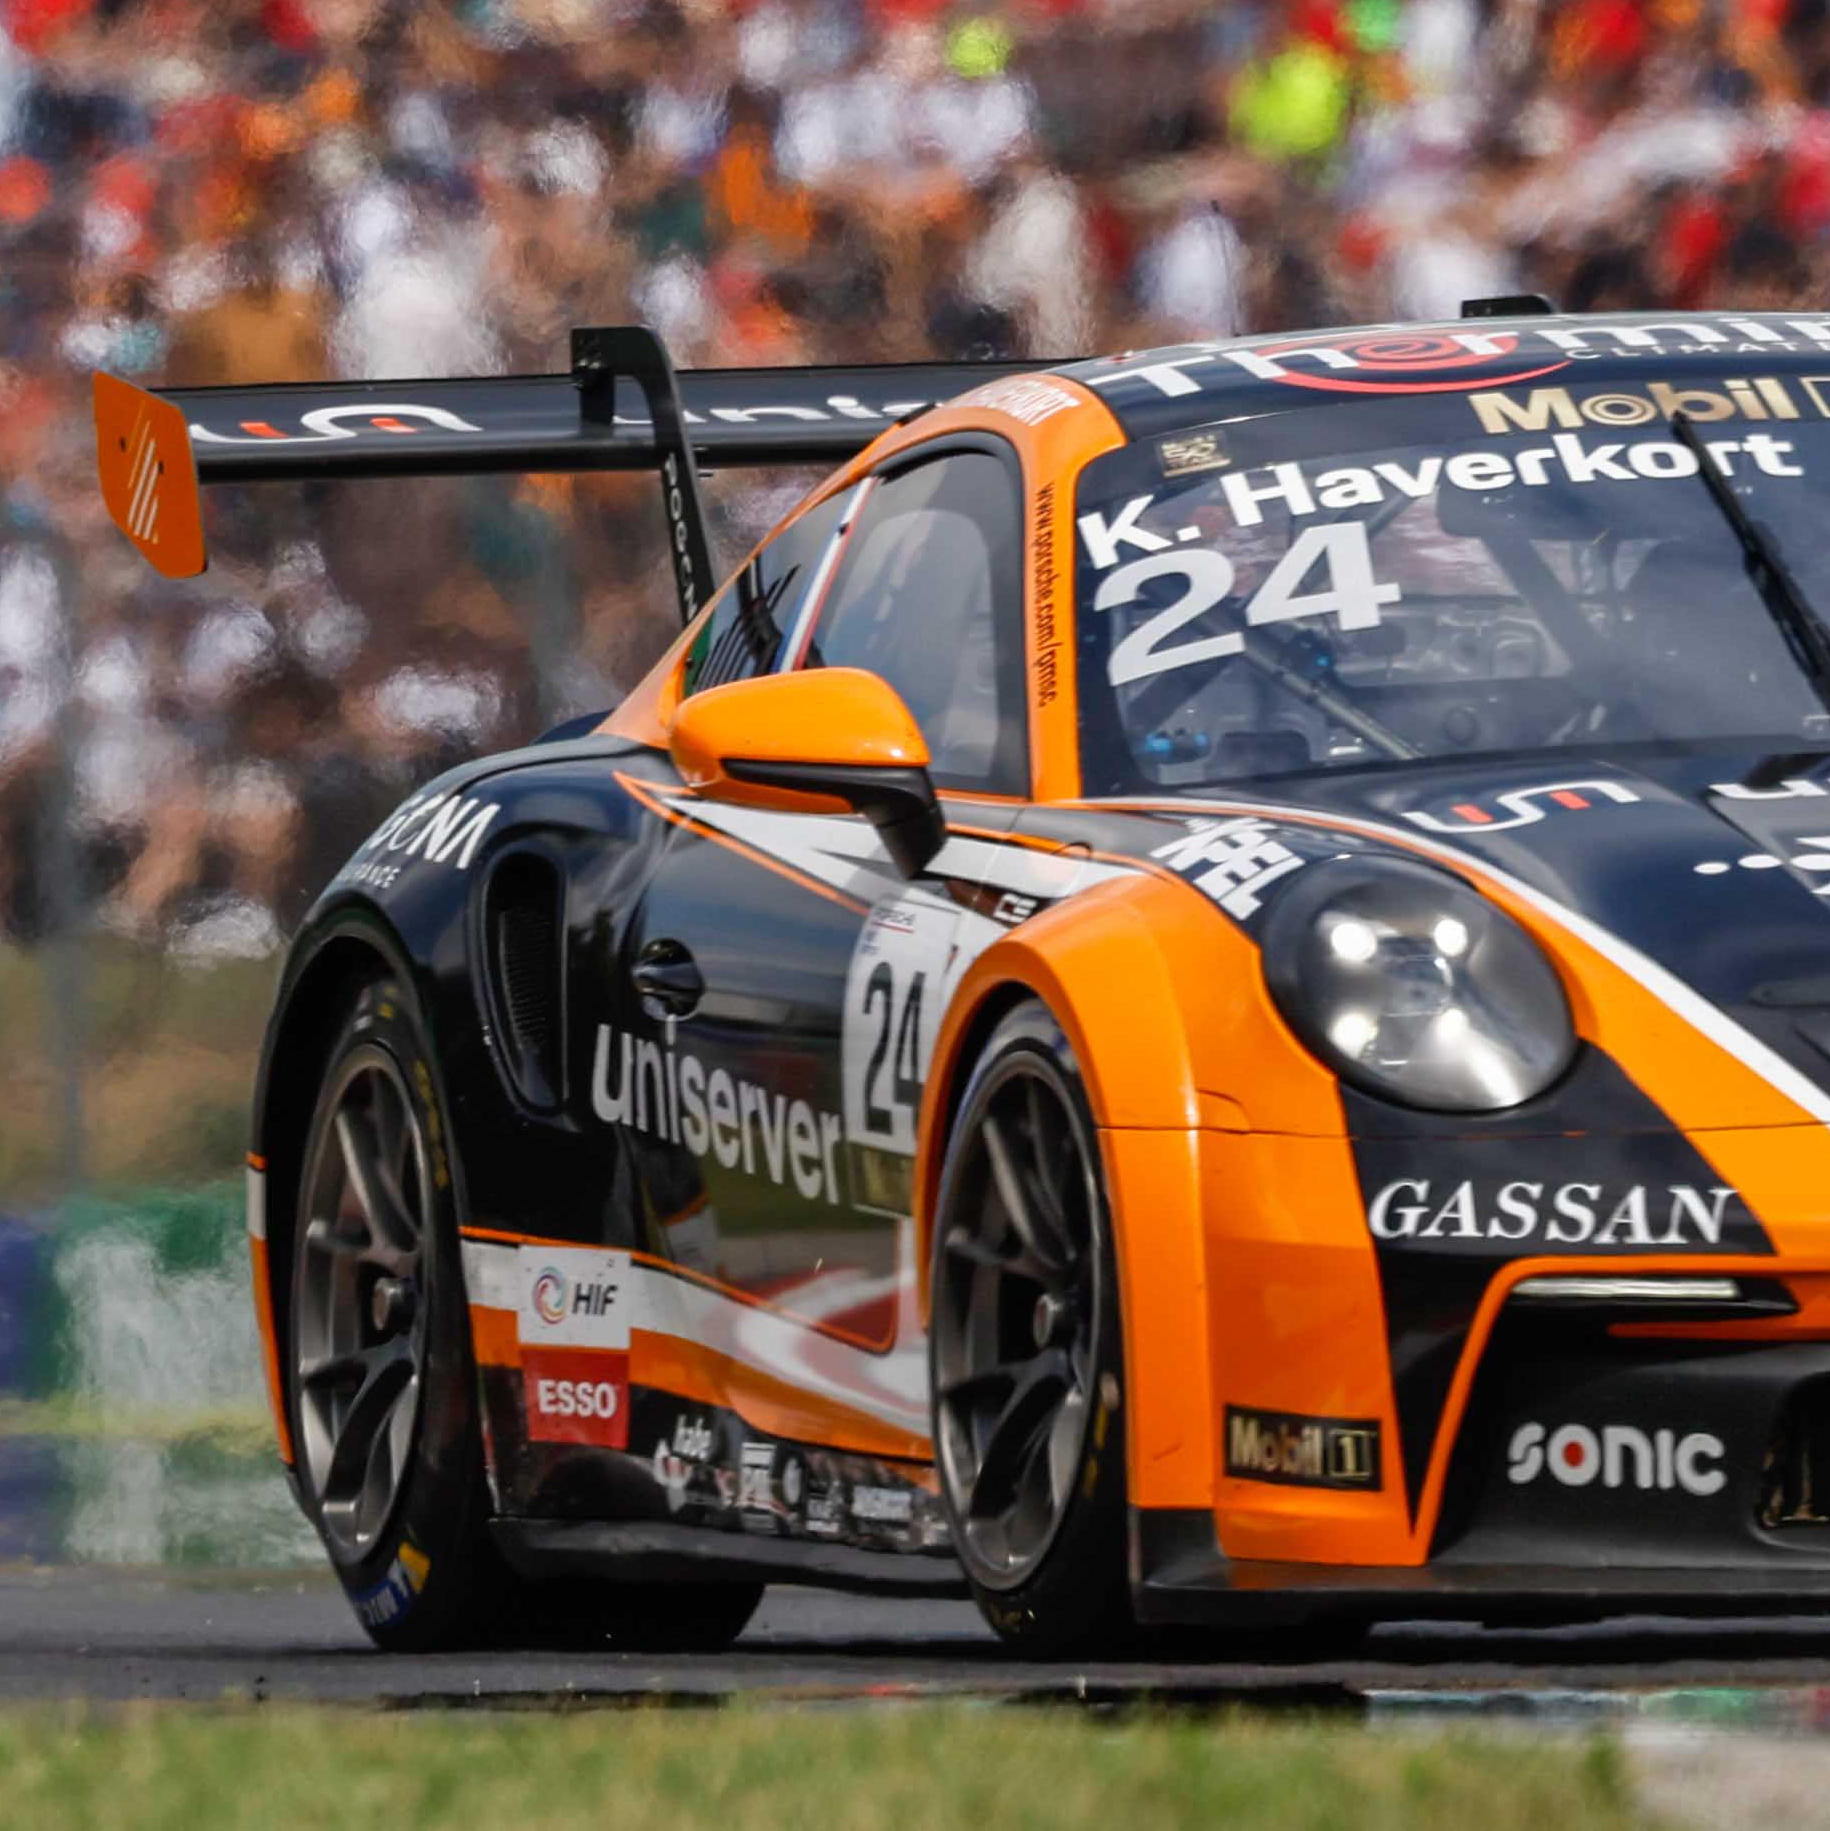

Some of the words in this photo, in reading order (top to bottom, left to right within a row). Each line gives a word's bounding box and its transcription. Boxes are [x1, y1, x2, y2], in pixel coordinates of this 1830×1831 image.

[1468, 377, 1801, 435] Mobil
[1077, 494, 1202, 570] K.
[1220, 432, 1805, 527] Haverkort
[1094, 521, 1401, 687] 24
[590, 1013, 845, 1206] uniserver
[862, 961, 926, 1139] 24
[1370, 1179, 1738, 1246] GASSAN
[537, 1378, 618, 1419] ESSO
